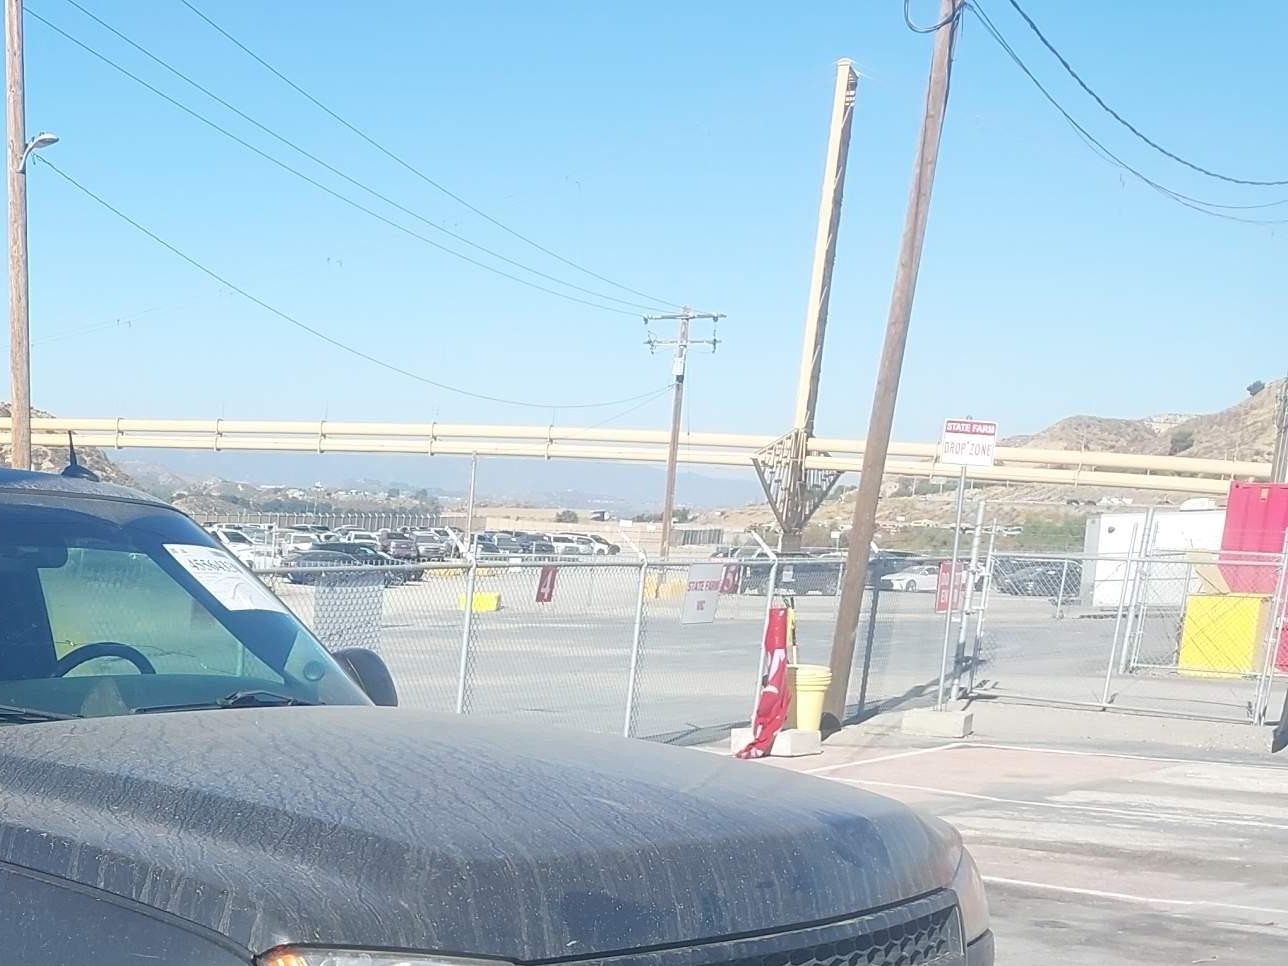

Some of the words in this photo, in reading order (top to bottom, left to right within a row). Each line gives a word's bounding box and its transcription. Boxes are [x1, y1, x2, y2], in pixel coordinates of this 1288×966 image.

[946, 423, 971, 432] STATE
[972, 424, 995, 434] FARM
[944, 442, 966, 454] DROP
[968, 443, 991, 456] ZONE
[541, 570, 553, 600] 4
[688, 580, 705, 592] STATE
